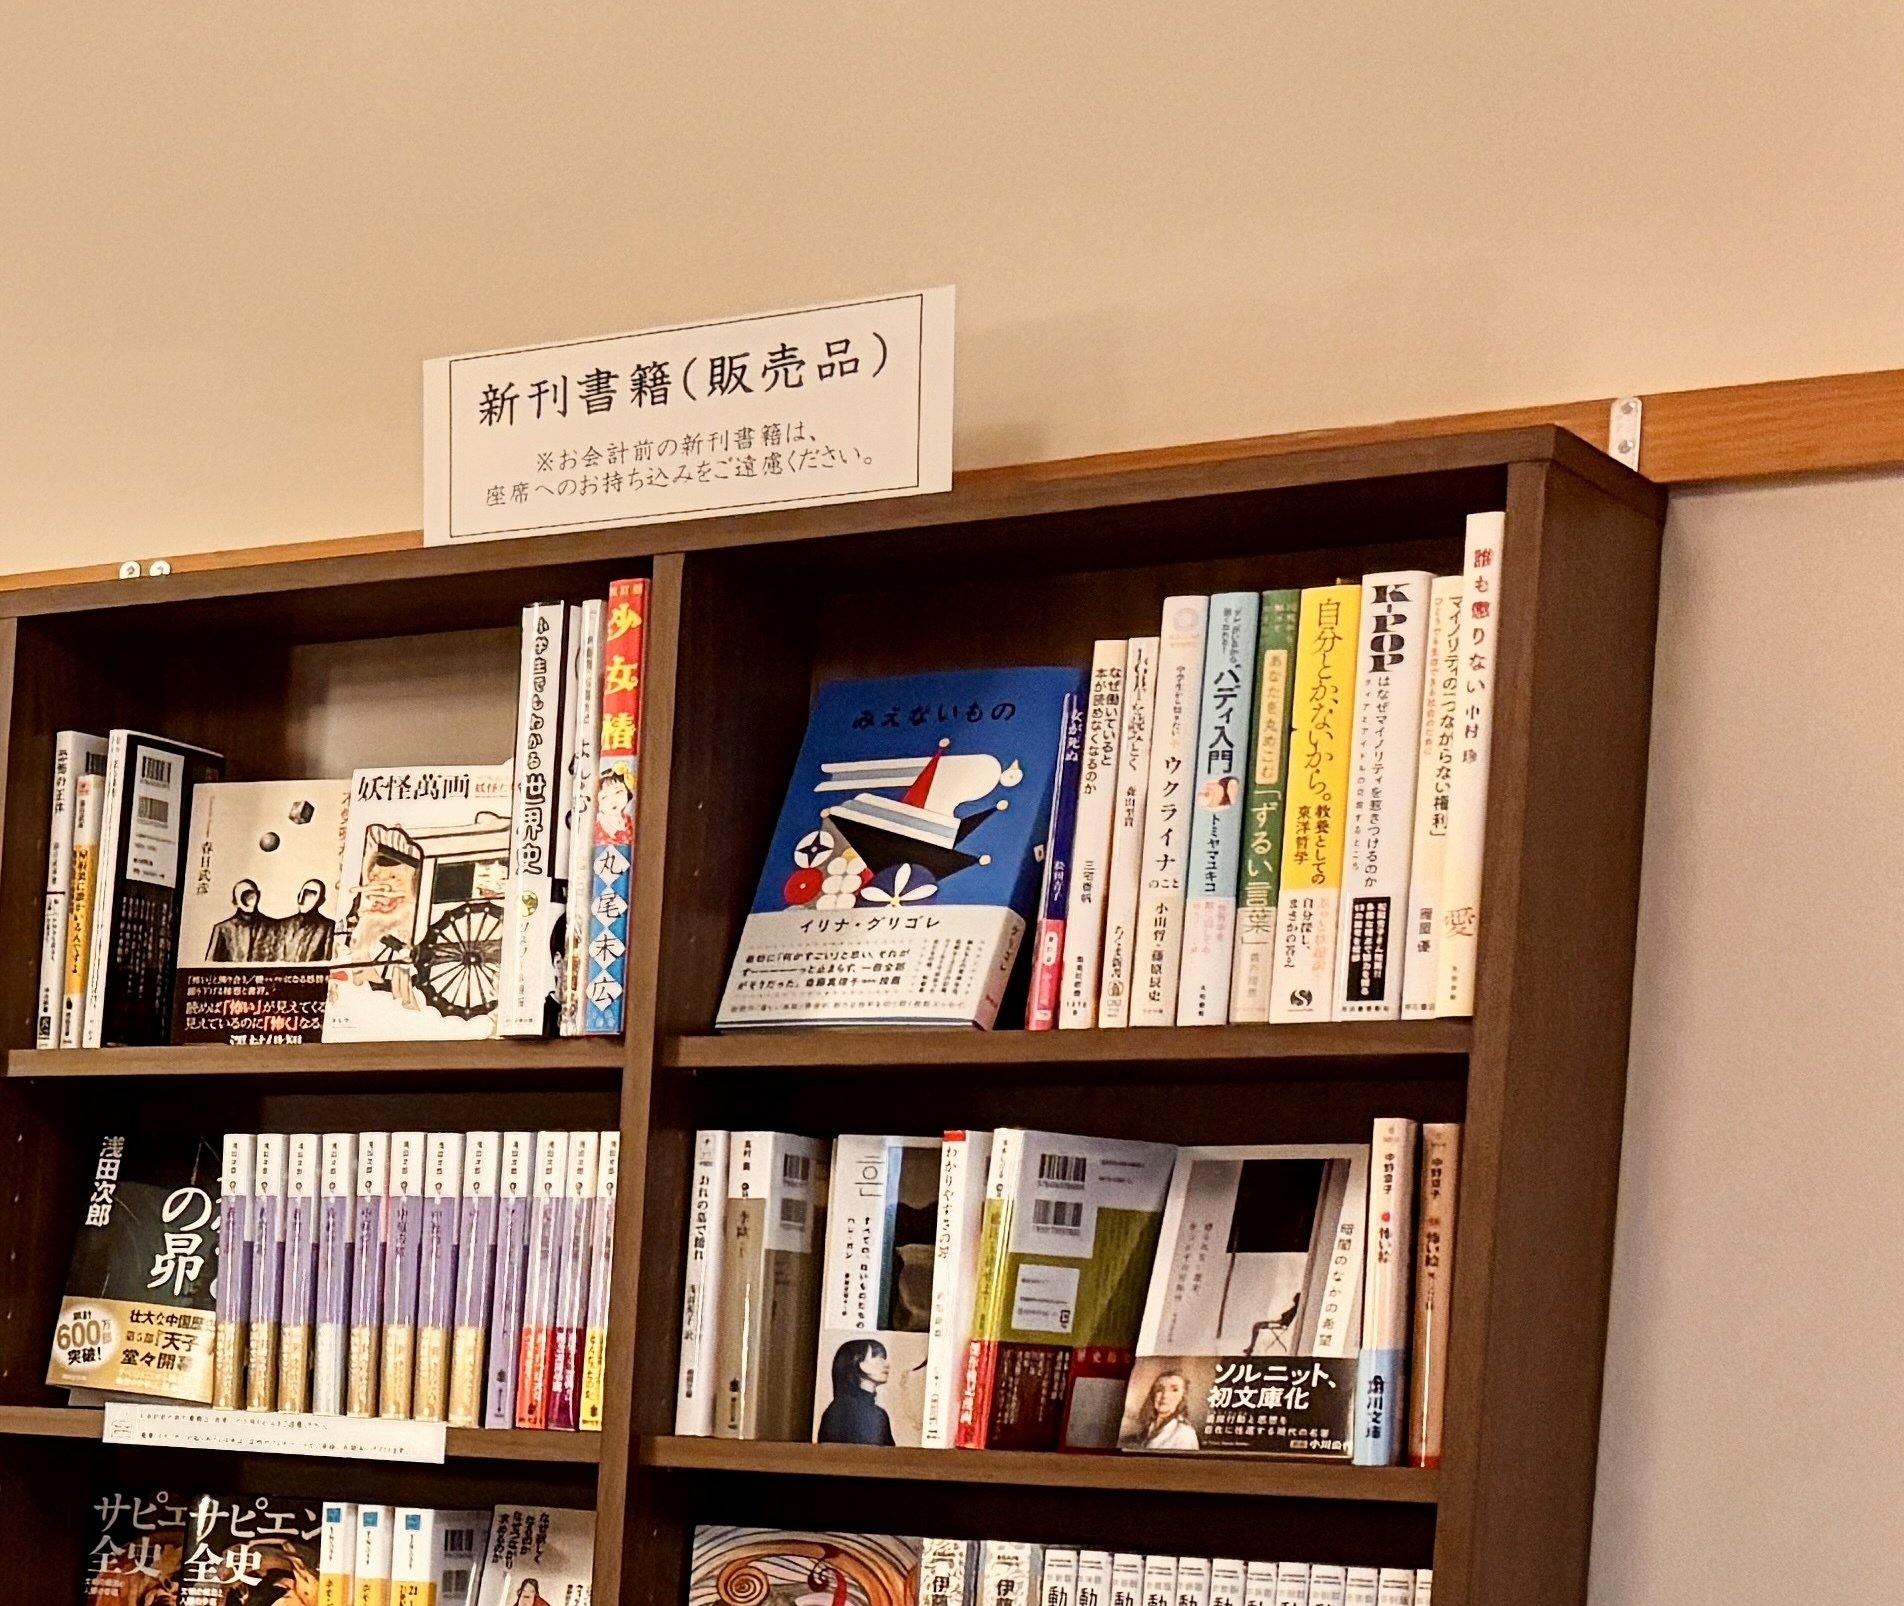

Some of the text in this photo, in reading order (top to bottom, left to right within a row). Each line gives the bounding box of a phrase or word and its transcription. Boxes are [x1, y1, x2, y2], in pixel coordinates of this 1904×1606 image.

[478, 331, 890, 428] 新刊書籍(販売品)
[485, 446, 875, 508] 座席へのお持ち込みをご遠慮ください。
[536, 421, 818, 473] ※お会計前の新刊書籍は、
[1368, 583, 1413, 674] K-POP
[600, 601, 643, 751] 少女椿
[852, 702, 1016, 730] みえないもの
[1307, 597, 1342, 803] 自分とか、ないから。
[1083, 667, 1109, 796] 本が読めなくなるのか
[1099, 667, 1122, 767] なぜ働いていると
[357, 773, 470, 802] 妖怪萬画
[1155, 755, 1181, 873] ウクライナ
[1364, 676, 1391, 888] はなぜマイノリティを惹きつけるのか
[1203, 812, 1222, 893] トミヤマユキコ
[1239, 785, 1283, 950] 「ずるい言葉」
[1294, 804, 1313, 866] 東洋哲学
[1310, 804, 1332, 886] 教養としての
[800, 916, 941, 934] イリナ・グリゴレ
[1148, 879, 1180, 890] のこと
[588, 849, 628, 1006] 丸尾末広
[83, 1134, 126, 1228] 浅田次郎
[938, 1146, 958, 1260] わかりやすさの罪
[1318, 1222, 1355, 1348] 暗闇のなかの希望
[55, 1320, 103, 1348] 600
[67, 1345, 103, 1367] 突破!
[1207, 1386, 1310, 1410] 初文庫化
[1213, 1362, 1338, 1390] ソルニット、
[93, 1490, 187, 1528] サピエ
[88, 1539, 163, 1577] 全史
[182, 1543, 263, 1586] 全史
